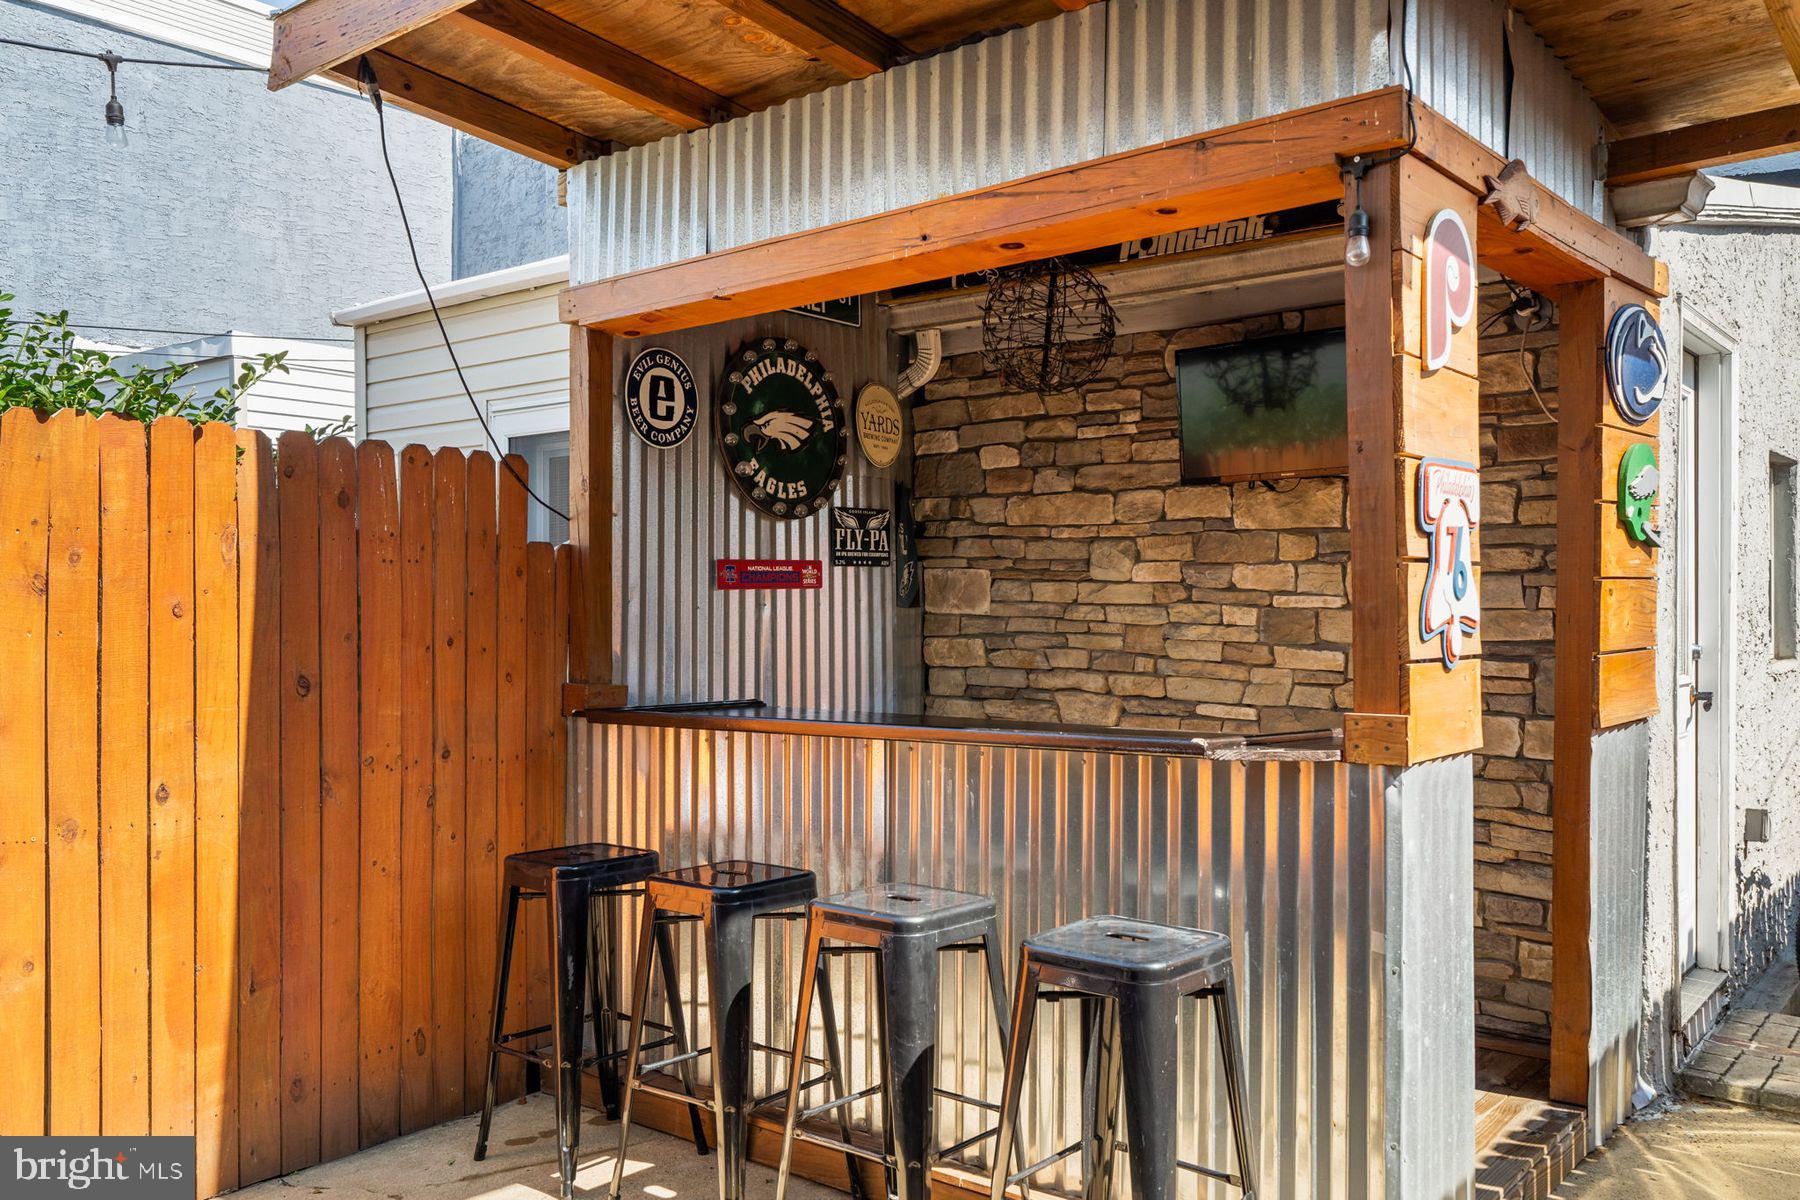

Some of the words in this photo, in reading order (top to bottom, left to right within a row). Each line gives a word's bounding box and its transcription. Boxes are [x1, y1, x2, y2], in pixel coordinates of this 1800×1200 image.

[633, 357, 654, 381] EVIL
[656, 354, 692, 390] GENIUS
[740, 357, 834, 433] PHILADELPHIA
[630, 397, 649, 435] BEER
[650, 405, 694, 443] COMPANY
[860, 411, 900, 437] YARDS
[835, 528, 889, 551] FLY-PA
